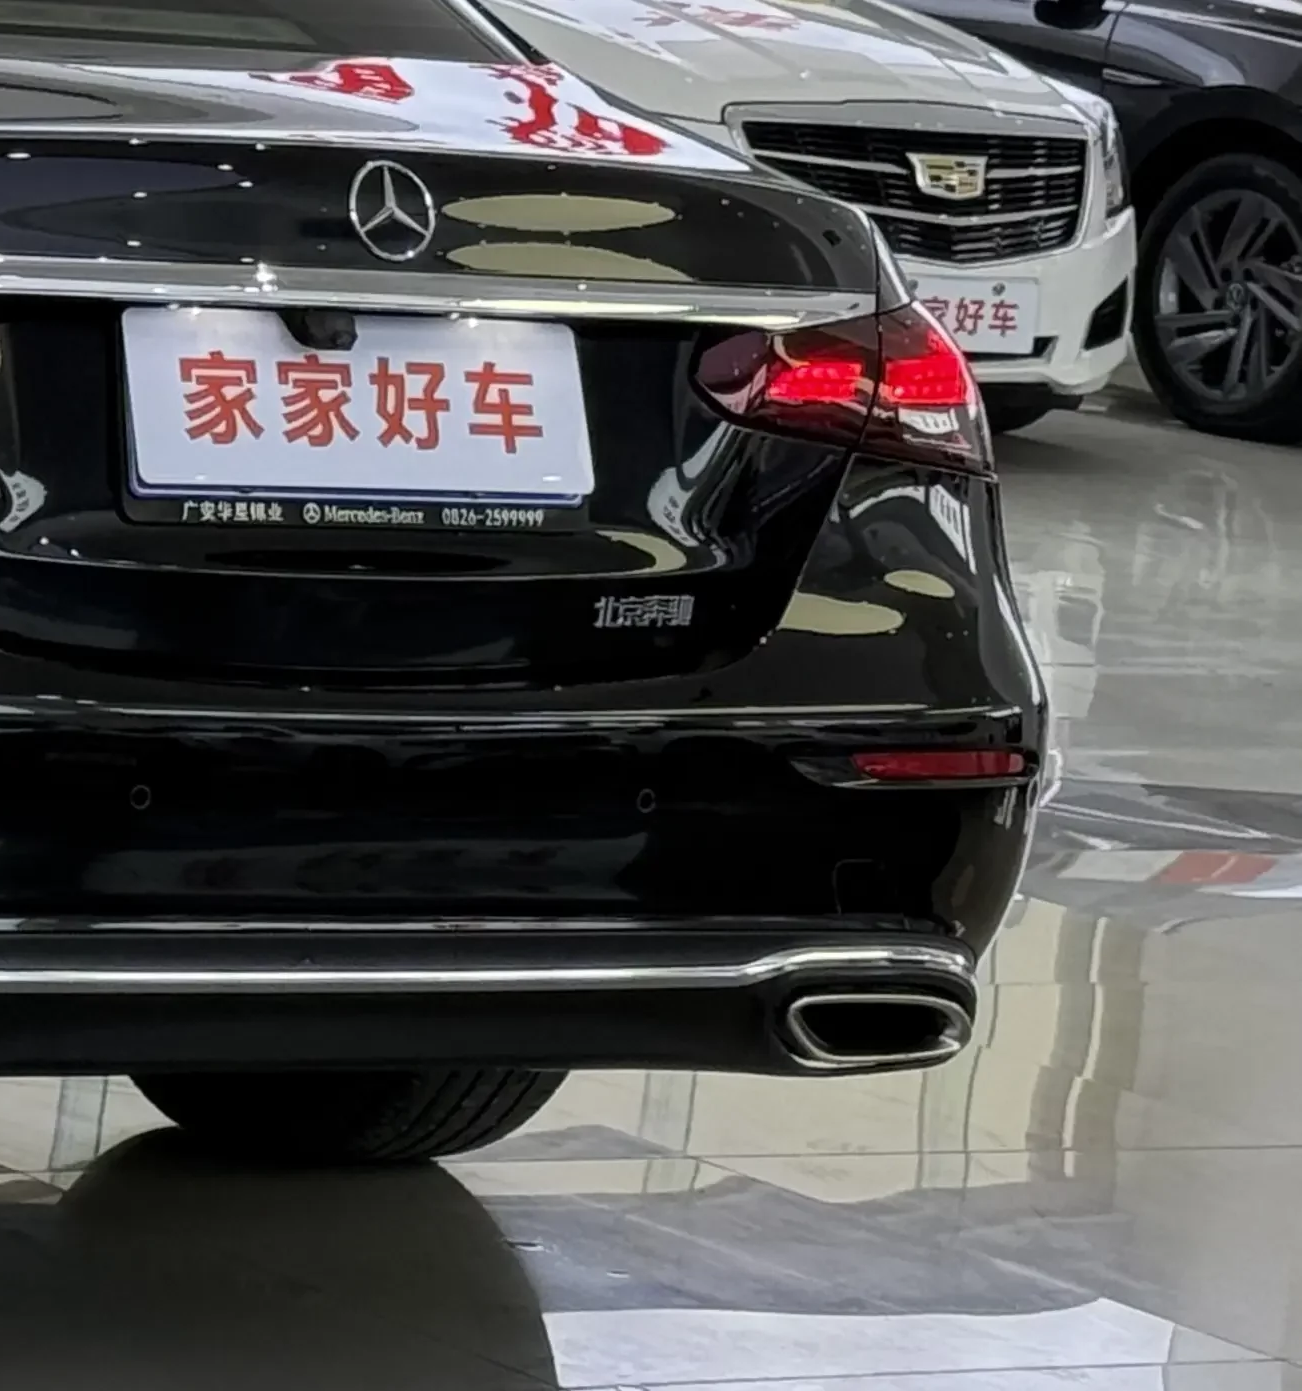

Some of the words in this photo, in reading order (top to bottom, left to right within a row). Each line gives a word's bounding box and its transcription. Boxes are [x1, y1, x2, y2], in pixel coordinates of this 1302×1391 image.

[178, 350, 544, 454] 家家好车
[324, 505, 424, 524] Mercedes-Benz
[593, 594, 695, 628] 北京奔驰
